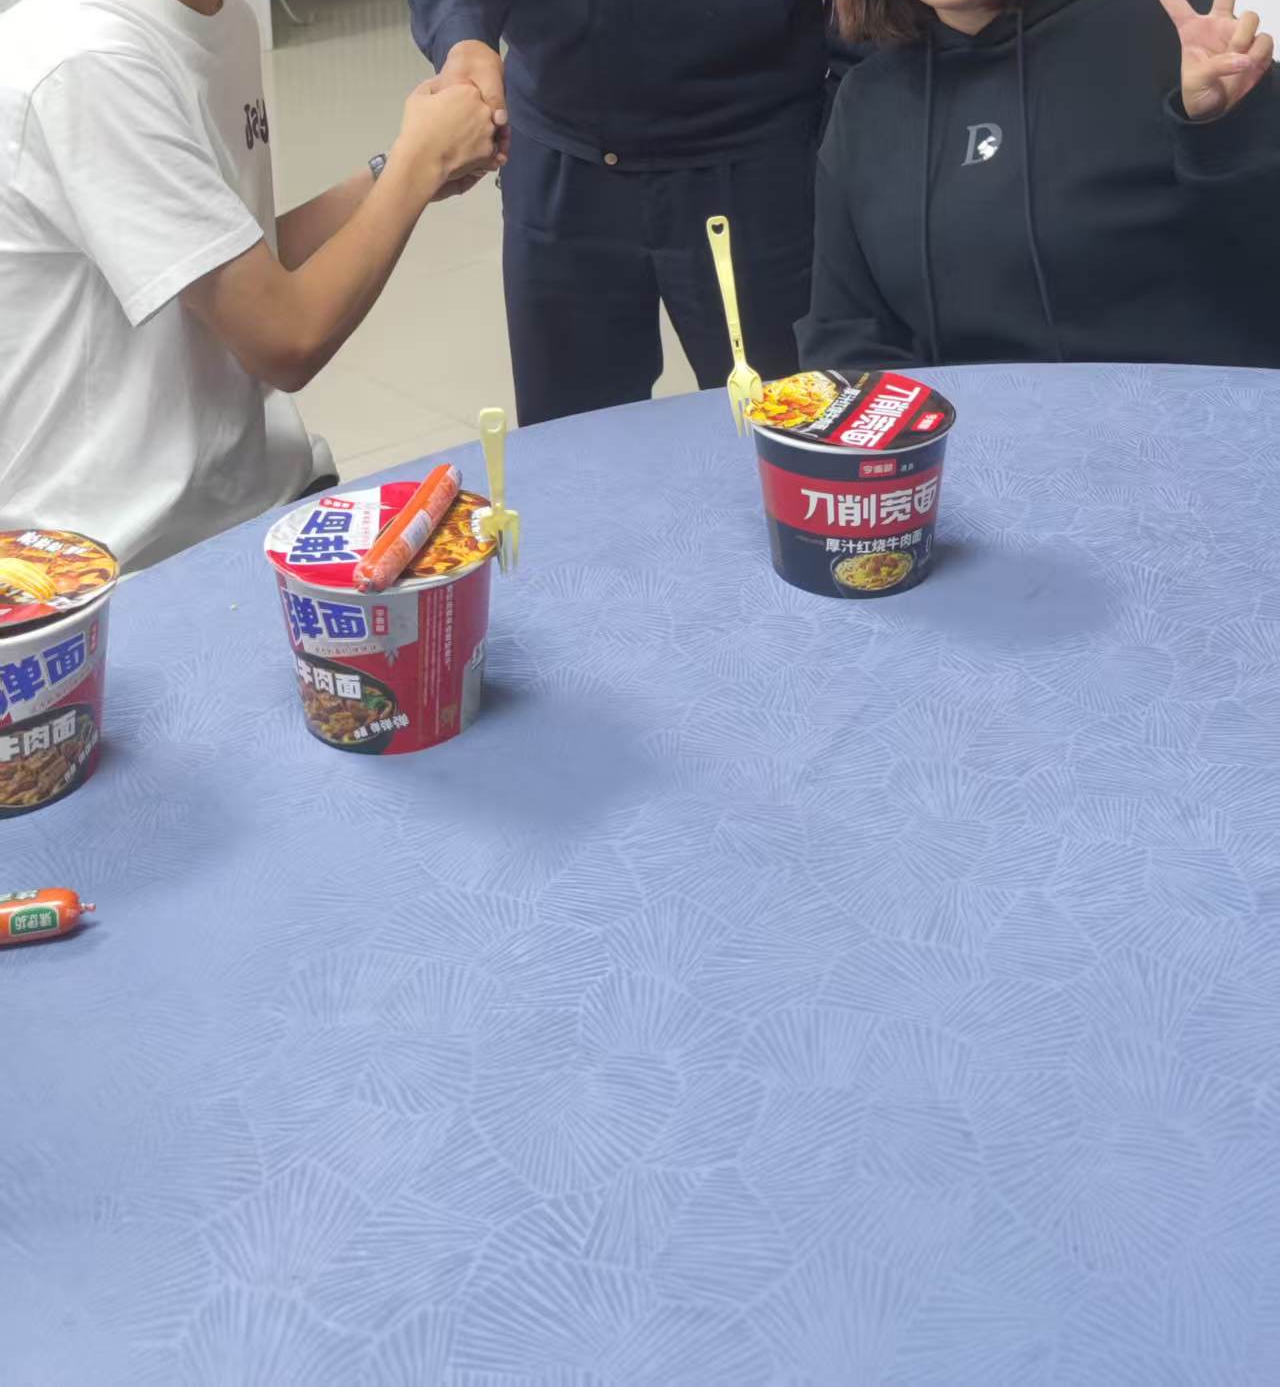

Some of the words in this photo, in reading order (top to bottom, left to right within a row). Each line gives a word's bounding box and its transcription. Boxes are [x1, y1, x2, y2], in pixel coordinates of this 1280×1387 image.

[840, 384, 921, 448] 刀削宽面
[801, 475, 938, 528] 刀削宽面
[288, 509, 358, 563] 弹面
[826, 528, 923, 554] 厚汁红烧牛肉面
[281, 590, 367, 641] 弹面
